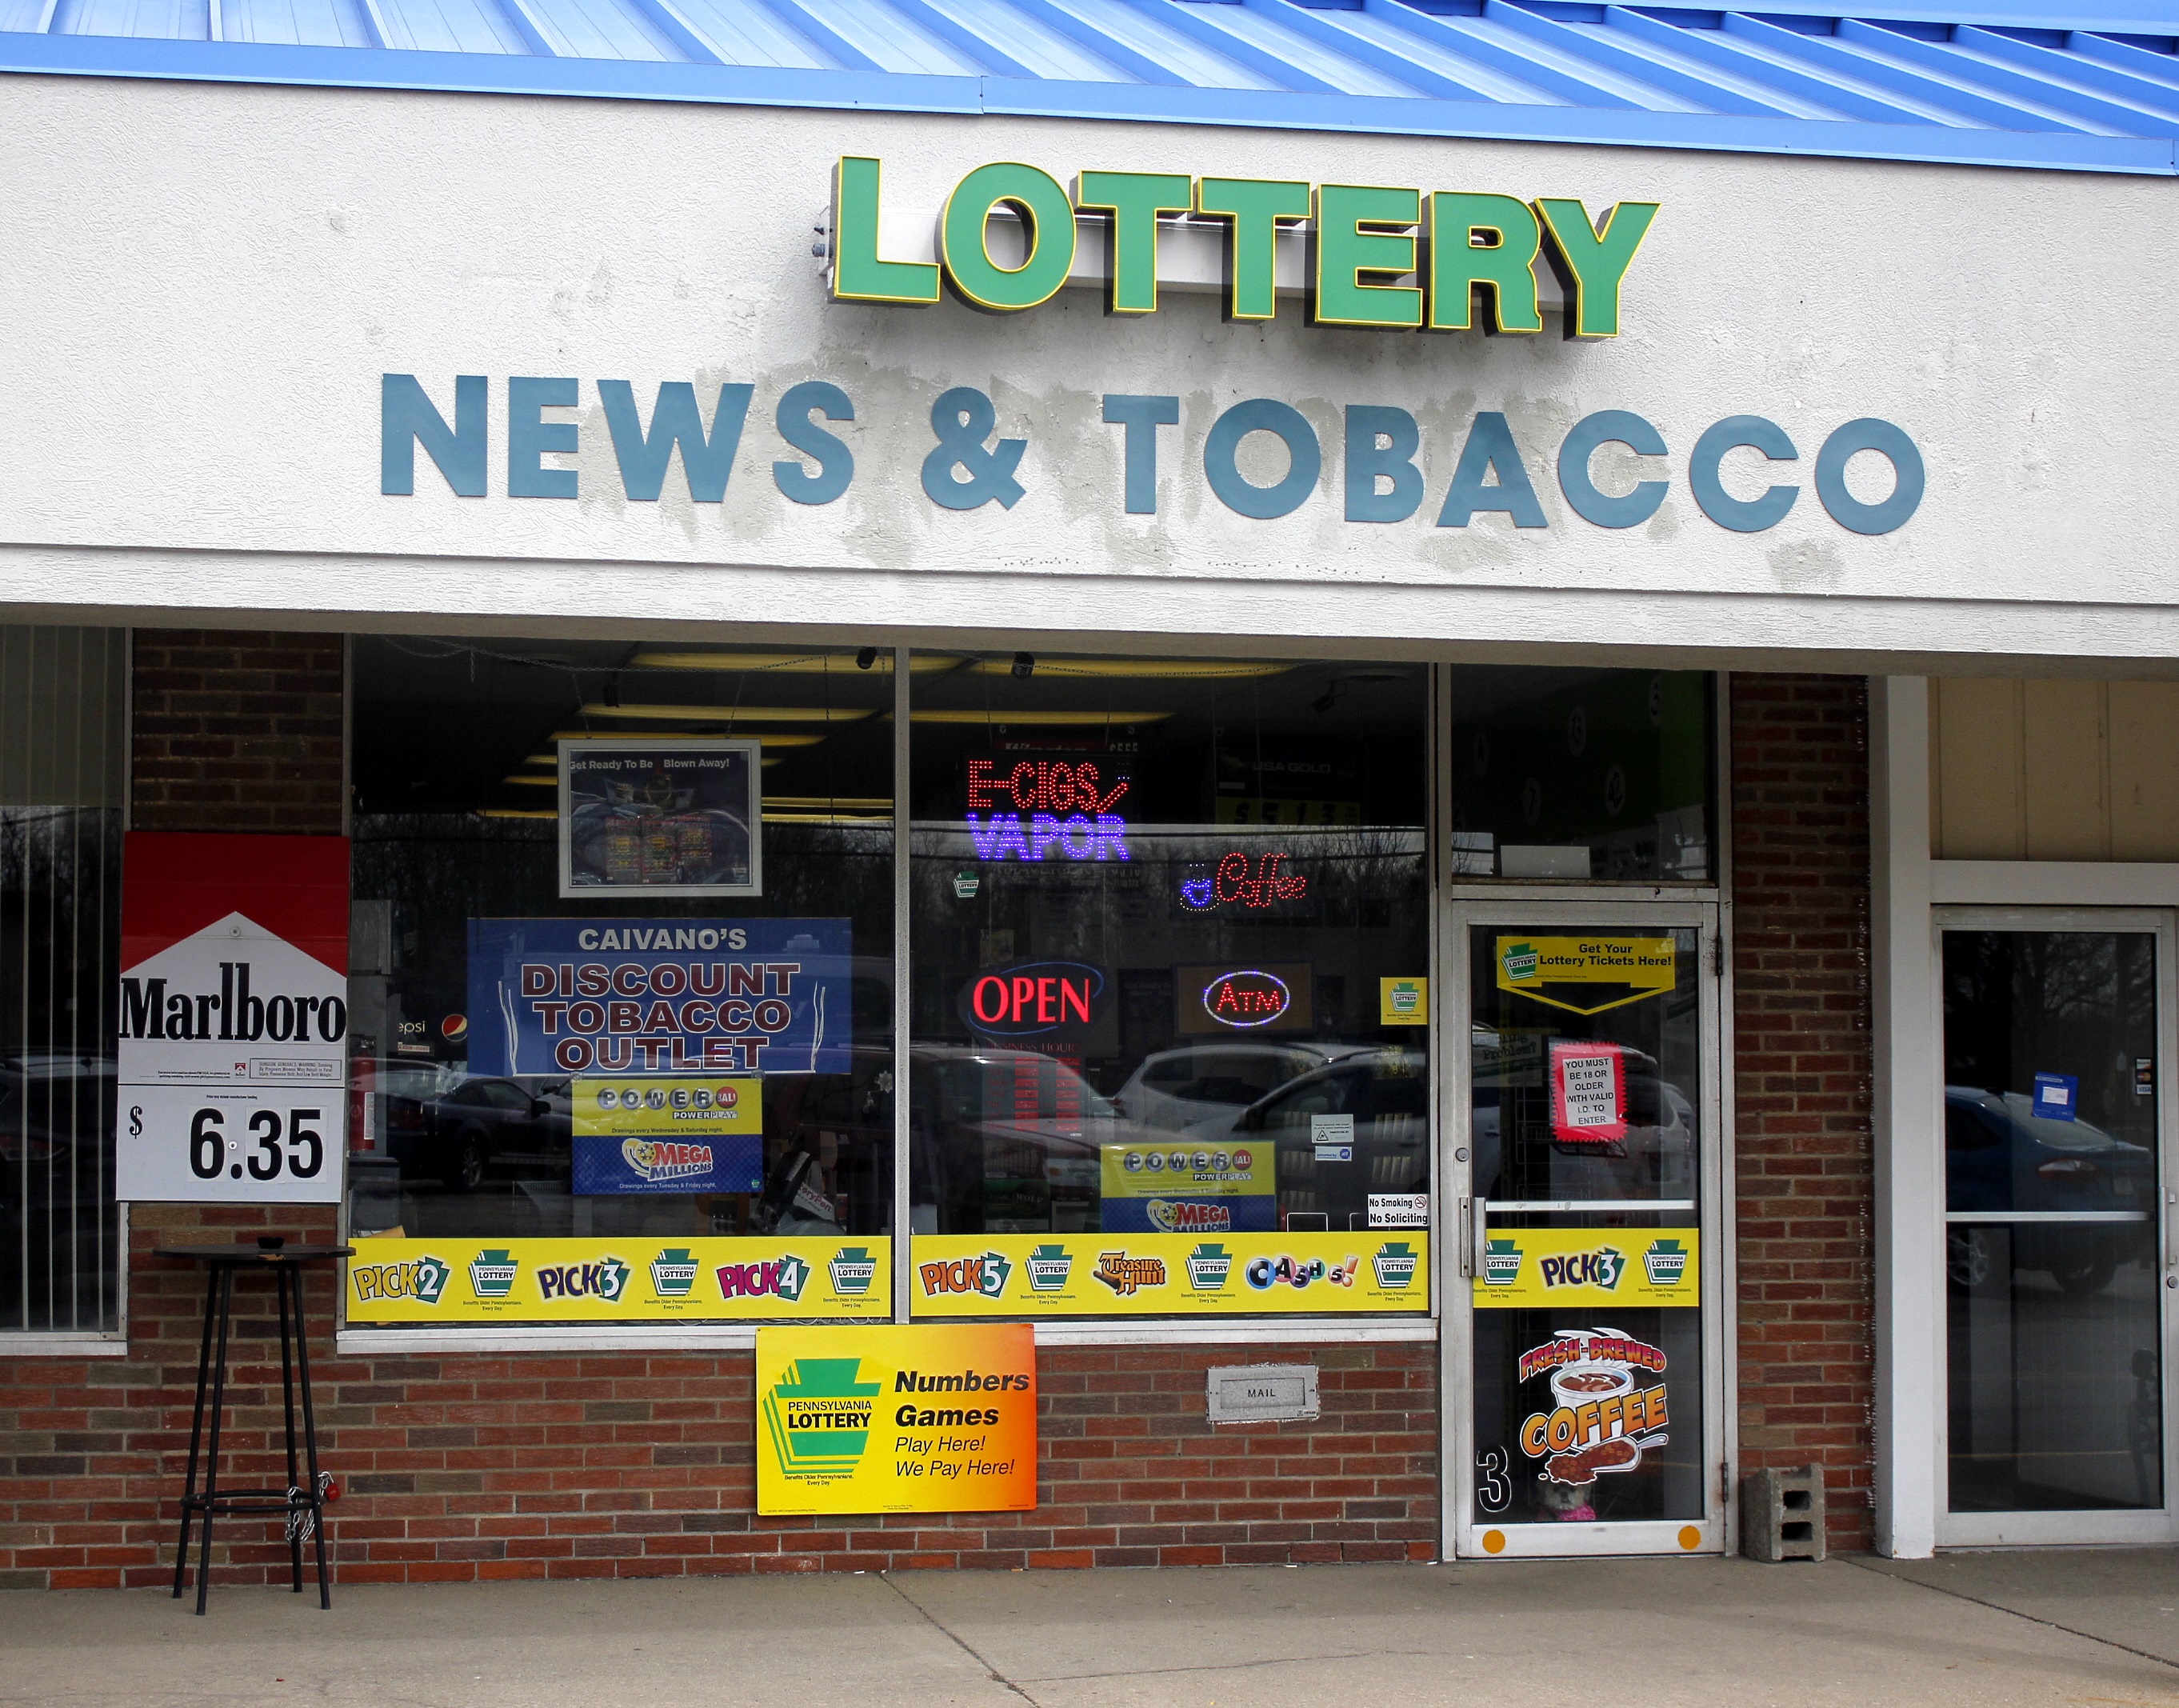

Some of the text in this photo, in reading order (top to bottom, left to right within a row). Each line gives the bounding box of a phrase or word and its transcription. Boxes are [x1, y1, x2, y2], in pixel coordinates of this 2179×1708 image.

[832, 156, 1660, 338] LOTTERY
[382, 373, 1925, 534] NEWS & TOBACCO
[570, 758, 730, 770] Get Ready To Be Blown Away!
[966, 813, 1130, 861] VAPOR
[1217, 852, 1306, 907] Coffee
[578, 929, 746, 950] CAIVANO'S
[1579, 944, 1633, 954] Get Your
[1509, 958, 1536, 968] LOTTERY
[1540, 955, 1671, 967] Lottery Tickets Here!
[522, 963, 800, 997] DISCOUNT
[118, 962, 346, 1042] Marlboro
[973, 975, 1090, 1022] OPEN
[533, 1000, 791, 1034] TOBACCO
[555, 1037, 769, 1070] OUTLET
[1565, 1058, 1609, 1069] YOU MUST
[1569, 1070, 1607, 1080] BE 18 OR
[1575, 1082, 1603, 1090] OLDER
[1566, 1092, 1613, 1103] WITH VALID
[1578, 1104, 1605, 1114] I.D. TO
[1578, 1115, 1606, 1125] ENTER
[129, 1105, 324, 1181] $ 6.35
[654, 1143, 711, 1165] MEGA
[649, 1163, 712, 1179] MILLIONS
[1369, 1198, 1412, 1208] No Smoking
[1174, 1203, 1229, 1225] MEGA
[1370, 1214, 1427, 1224] No Soliciting
[1099, 1251, 1161, 1277] Treasure
[1195, 1265, 1228, 1273] LOTTERY
[1119, 1268, 1165, 1295] Hunt
[1520, 1338, 1665, 1382] FRESH-BREWED
[895, 1370, 1029, 1392] Numbers
[1248, 1389, 1276, 1398] MAIL
[789, 1401, 872, 1411] PENNSYLVANIA
[895, 1404, 999, 1426] Games
[789, 1413, 871, 1428] LOTTERY
[1521, 1385, 1668, 1455] COFFEE
[895, 1435, 986, 1454] Play Here!
[896, 1459, 1014, 1479] We Pay Here!
[1477, 1446, 1512, 1512] 3
